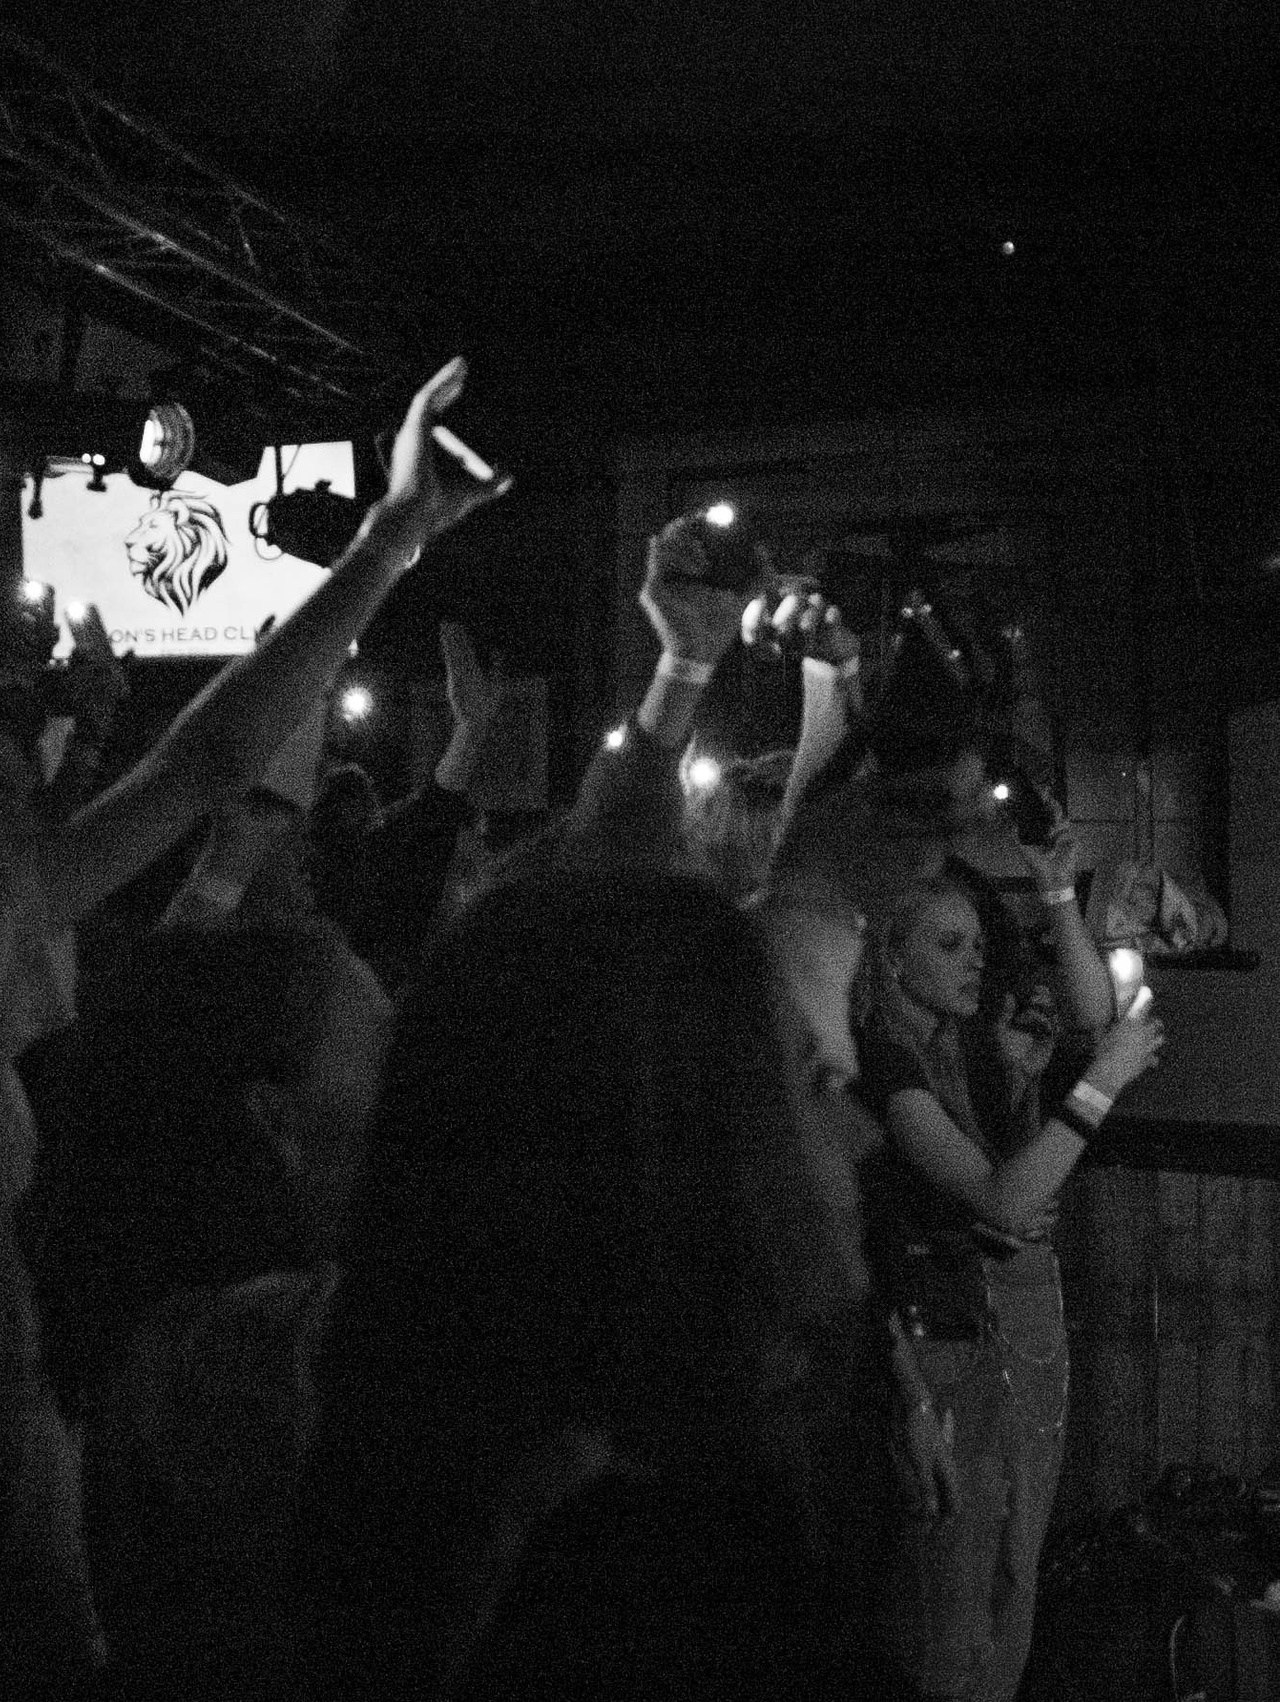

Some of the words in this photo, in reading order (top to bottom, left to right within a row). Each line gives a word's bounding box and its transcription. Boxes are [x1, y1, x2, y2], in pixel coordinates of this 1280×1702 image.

[110, 628, 156, 643] ON'S
[162, 626, 218, 642] HEAD
[223, 625, 254, 641] CL
